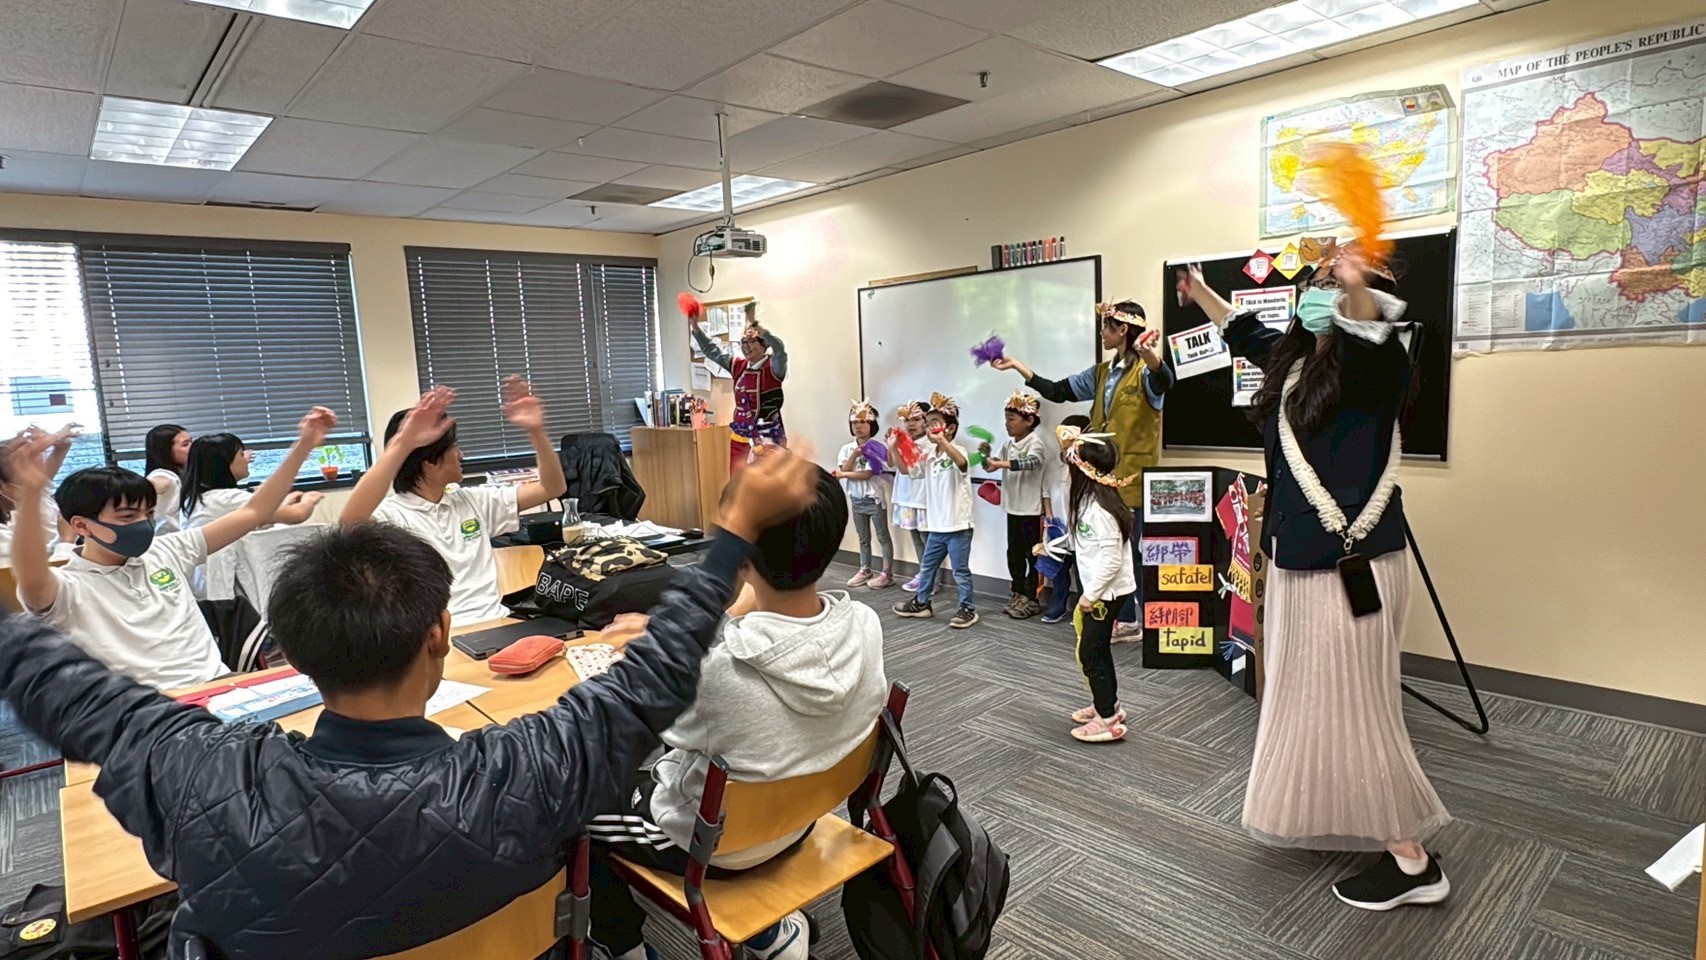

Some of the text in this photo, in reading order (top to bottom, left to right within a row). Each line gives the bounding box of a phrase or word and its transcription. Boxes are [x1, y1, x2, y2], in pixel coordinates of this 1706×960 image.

[1498, 65, 1521, 79] MAP
[1526, 60, 1543, 72] OF
[1546, 53, 1570, 68] THE
[1575, 39, 1632, 60] PEOPLE'S
[1638, 23, 1705, 48] REPUBLIC
[1185, 331, 1211, 350] TALK
[1145, 541, 1192, 563] 綁帶
[1160, 566, 1212, 586] safatel
[535, 571, 589, 611] BAPE
